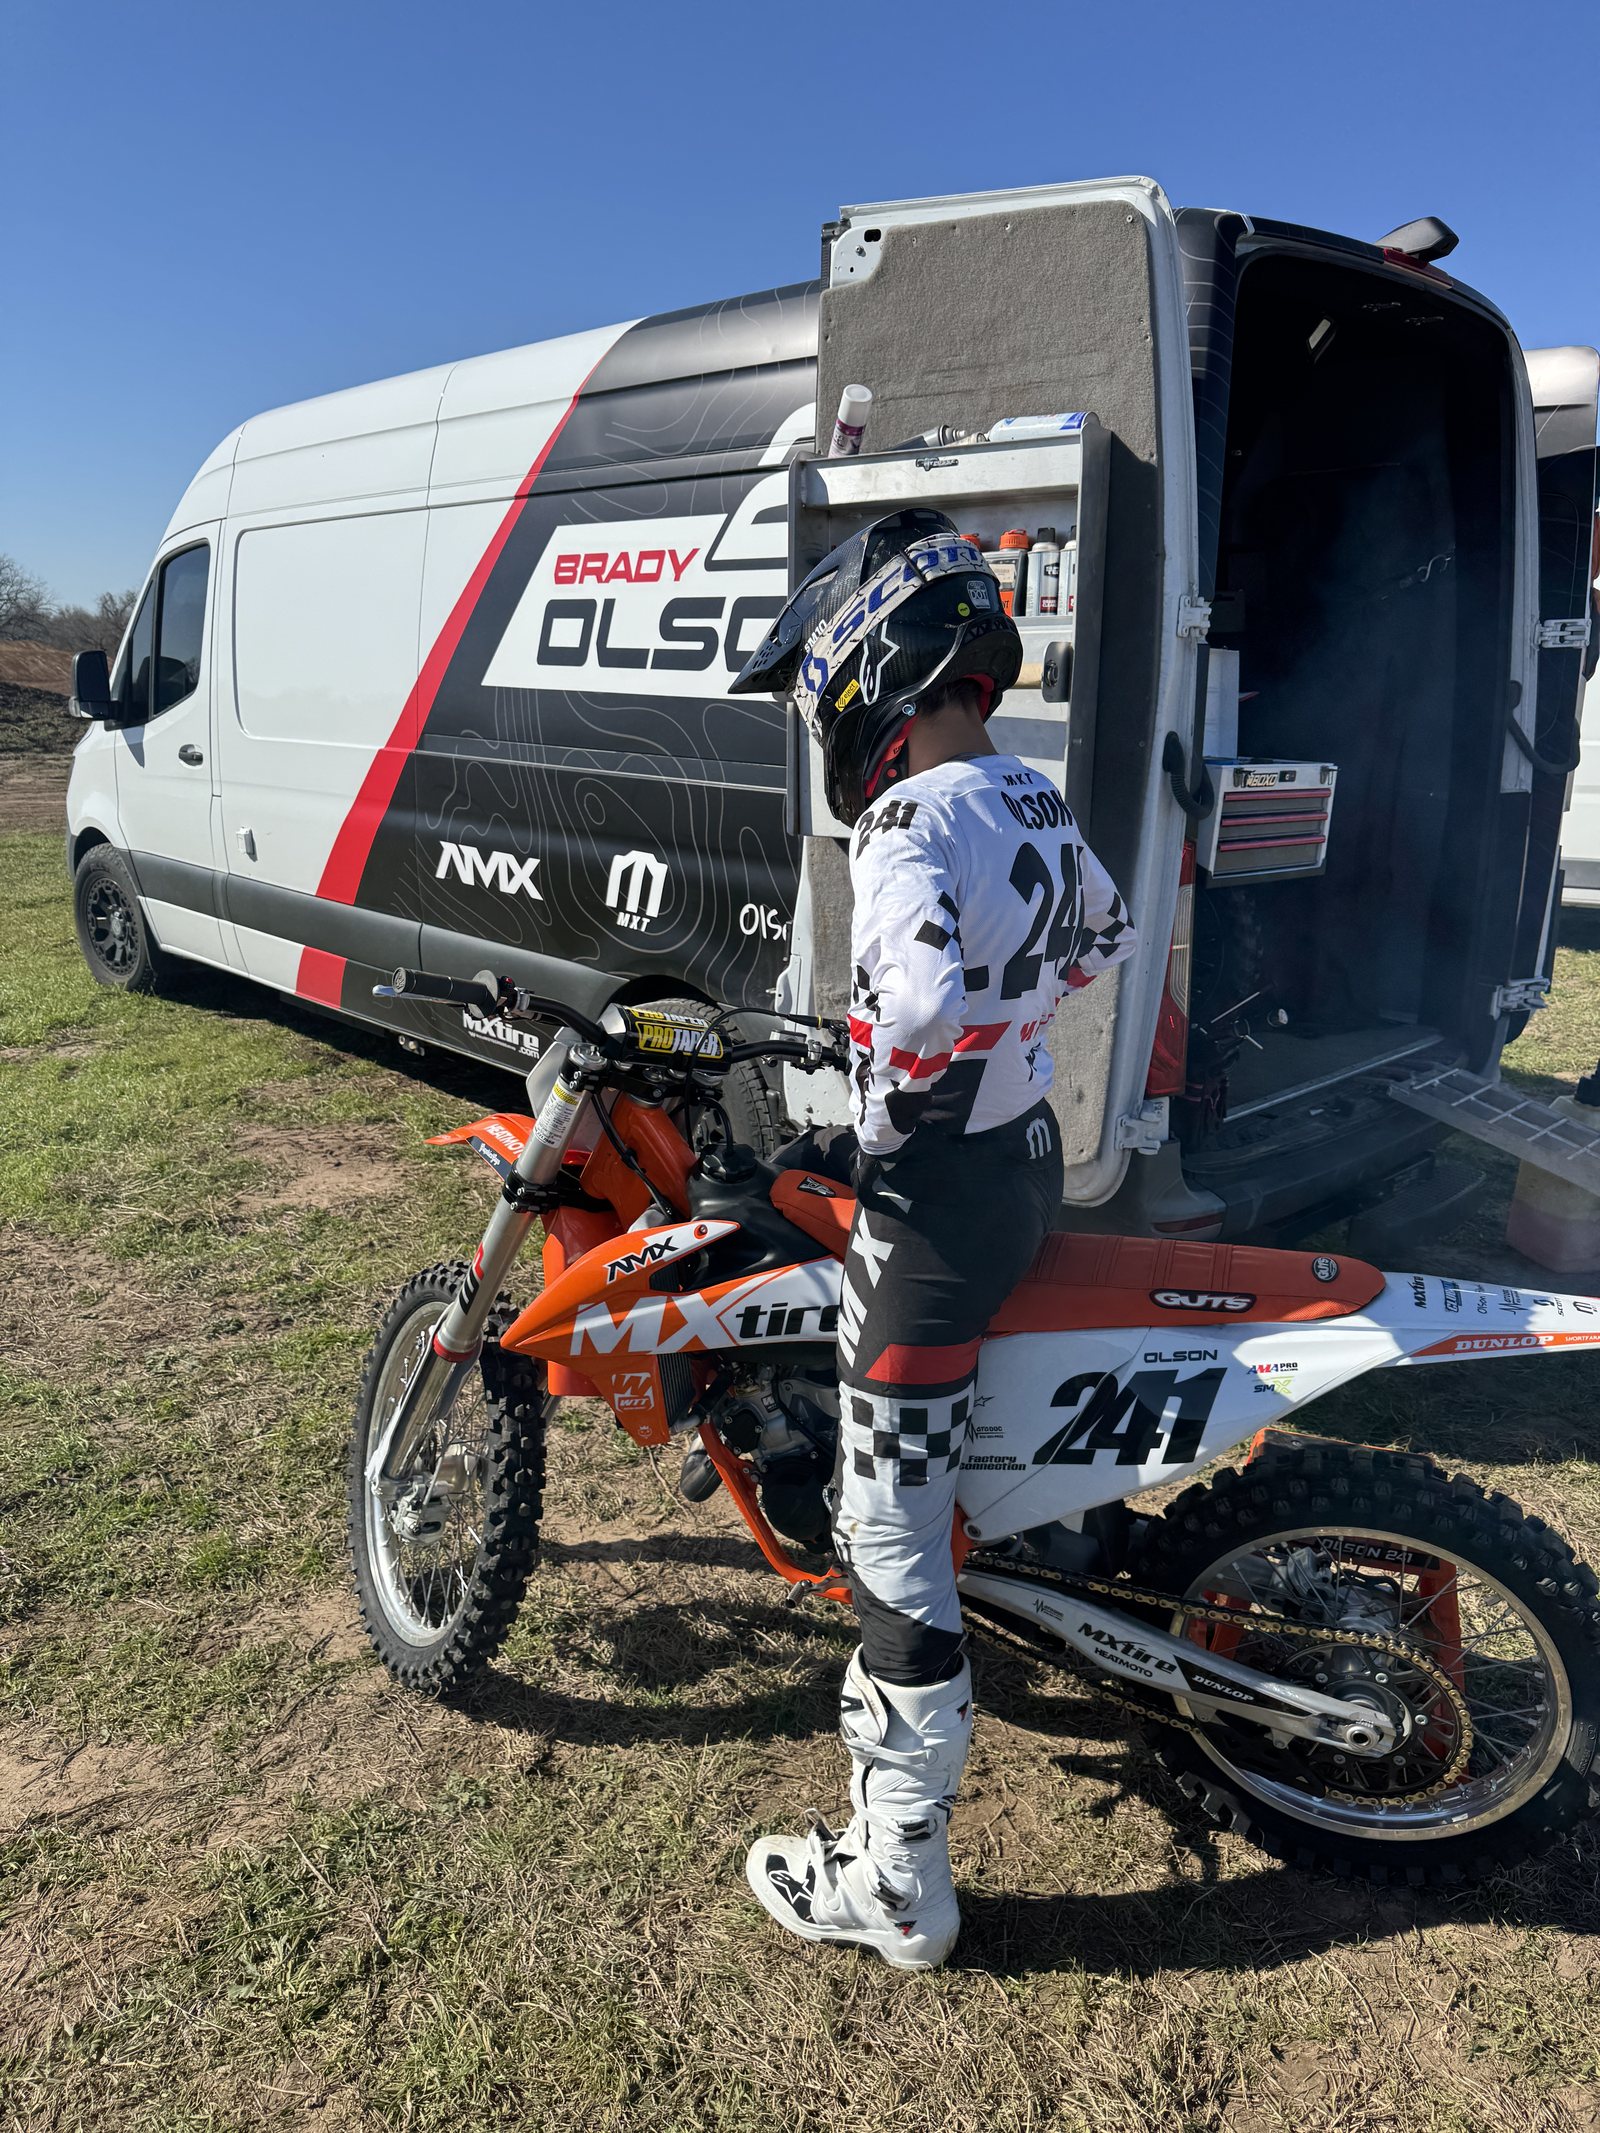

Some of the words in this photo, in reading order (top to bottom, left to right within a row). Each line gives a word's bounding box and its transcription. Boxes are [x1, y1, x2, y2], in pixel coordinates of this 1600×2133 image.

[554, 548, 700, 585] BRADY
[832, 545, 979, 657] SCOTT
[804, 619, 828, 652] SM10
[1001, 790, 1073, 831] OLSON
[856, 800, 918, 860] 241
[1154, 1292, 1252, 1311] GUTS
[1143, 1350, 1219, 1364] OLSON
[1455, 1335, 1554, 1351] DUNLOP
[1031, 1367, 1229, 1466] 241
[968, 1455, 1017, 1464] Factory
[1321, 1538, 1381, 1559] OLSON
[1385, 1549, 1414, 1564] 241
[1077, 1622, 1179, 1675] MXtire
[1094, 1647, 1154, 1679] HEATMOTO
[1191, 1674, 1256, 1702] DUNLOP
